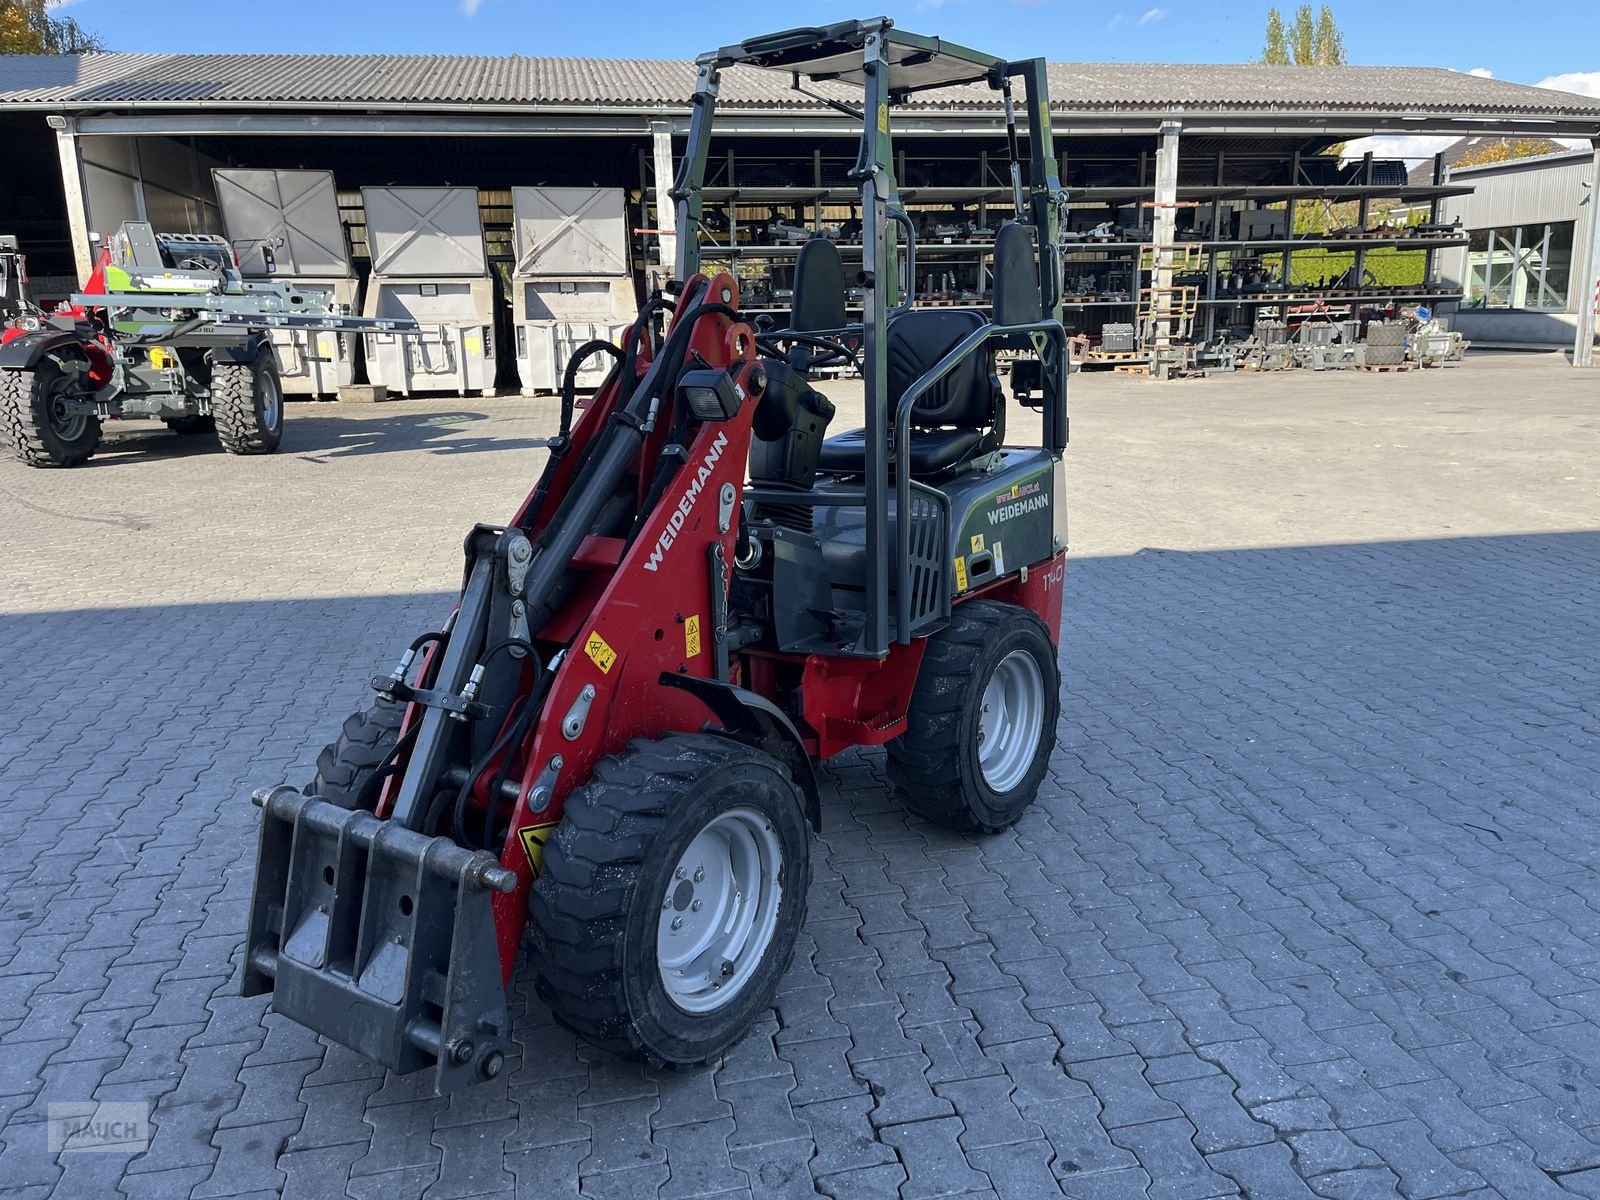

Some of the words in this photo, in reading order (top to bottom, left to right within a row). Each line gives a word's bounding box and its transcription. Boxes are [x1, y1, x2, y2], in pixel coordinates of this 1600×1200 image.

[643, 431, 729, 572] WEIDEMANN
[987, 493, 1049, 526] WEIDEMANN
[1042, 564, 1063, 592] 1140
